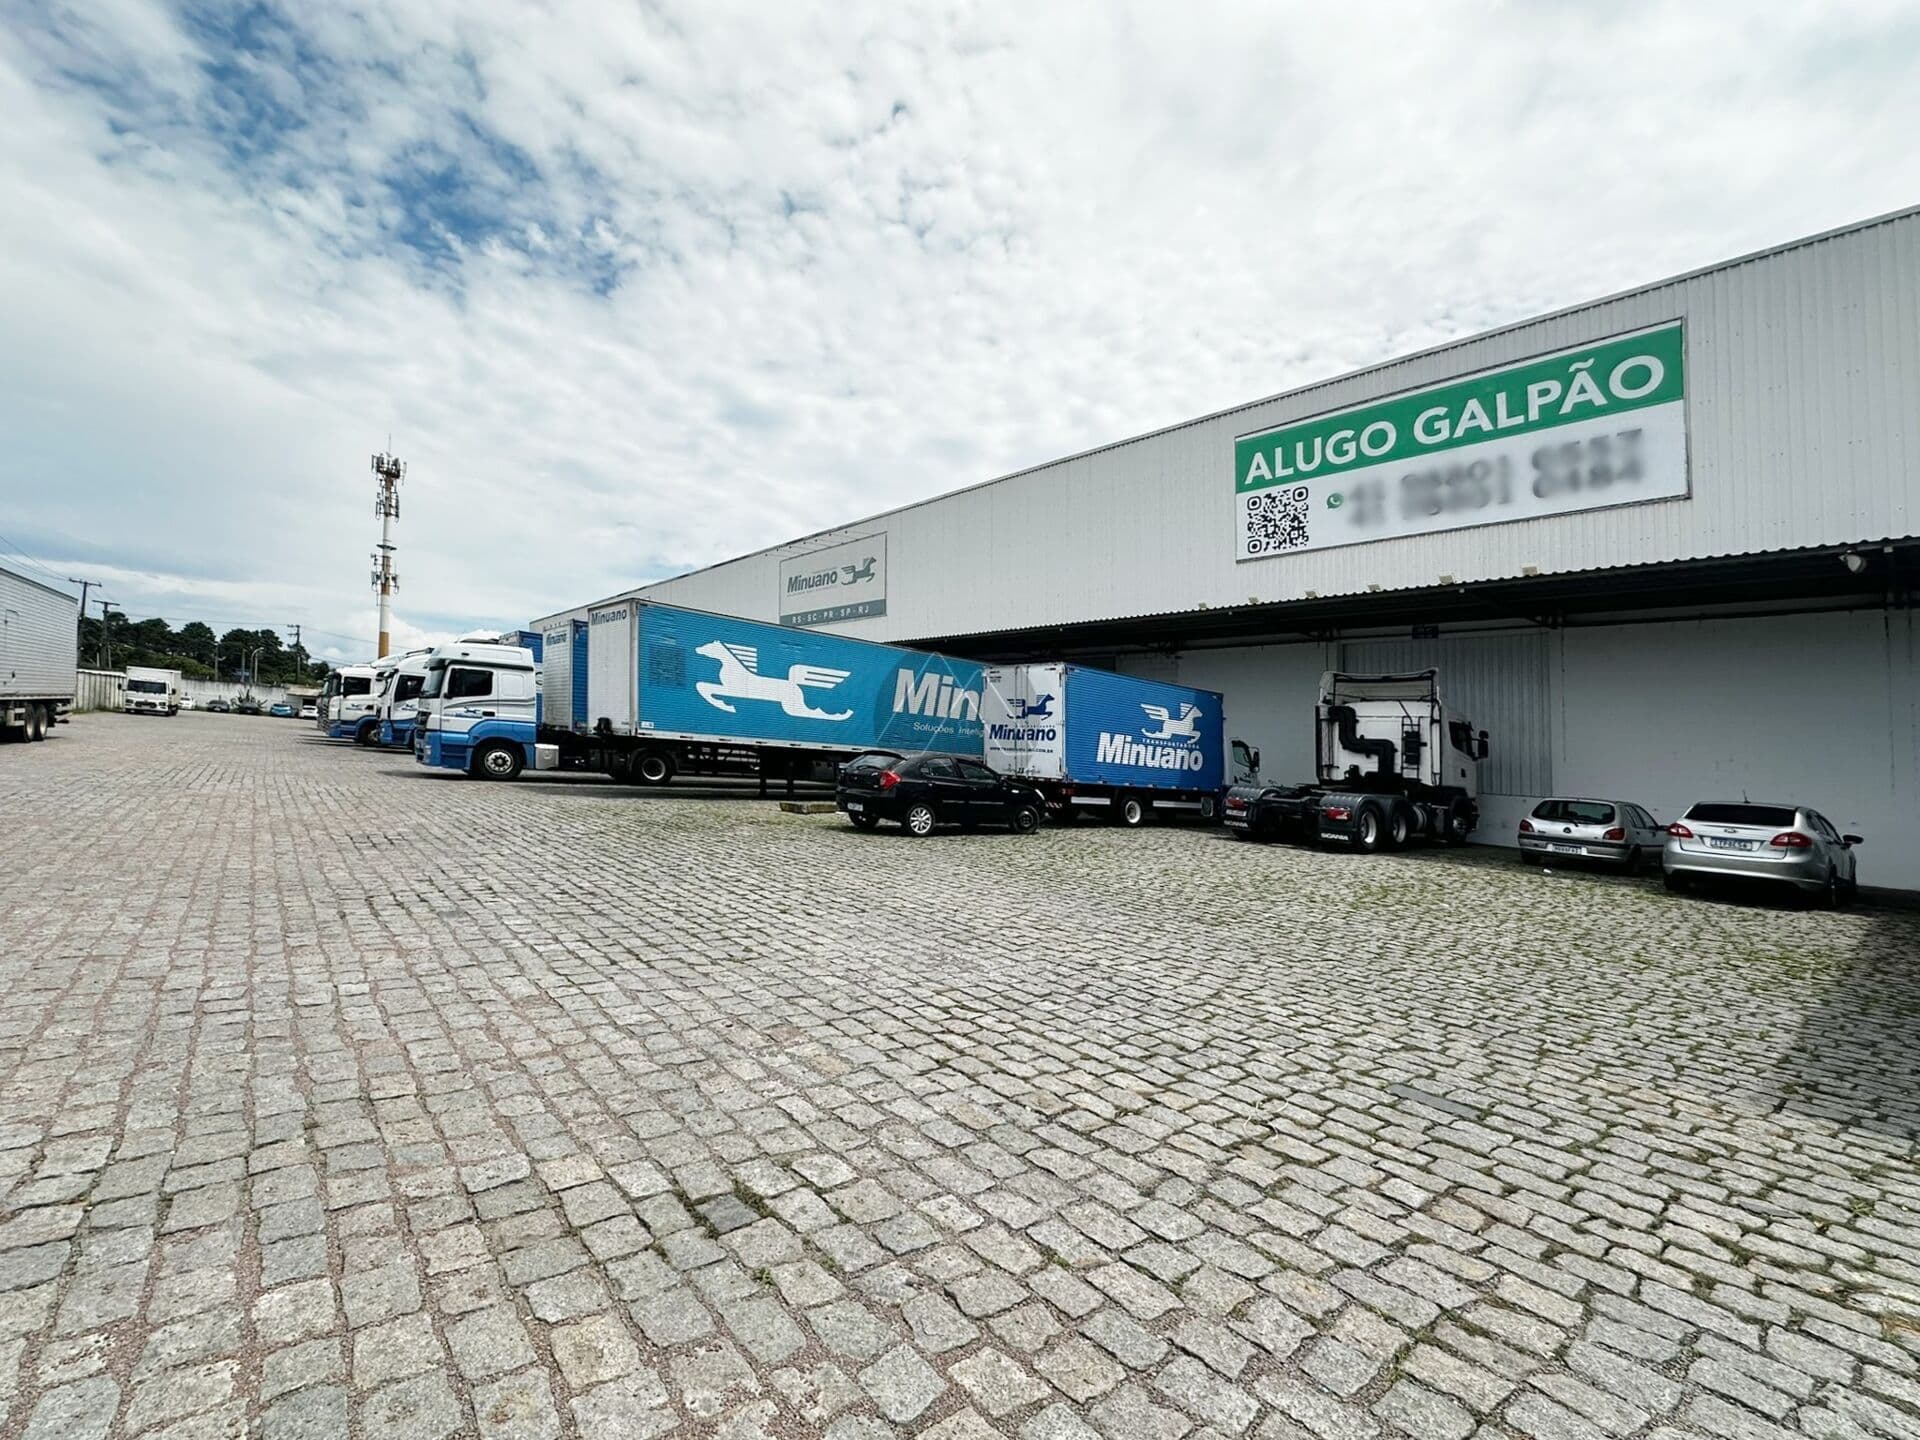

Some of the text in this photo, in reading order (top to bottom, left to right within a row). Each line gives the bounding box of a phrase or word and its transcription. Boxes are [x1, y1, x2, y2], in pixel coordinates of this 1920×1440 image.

[1244, 355, 1665, 485] ALUGO GALPÃO
[786, 570, 838, 593] Minuano
[591, 608, 628, 626] Minuano
[892, 668, 985, 724] Min
[989, 724, 1057, 741] Minuano
[1096, 732, 1204, 771] Minuano
[1321, 832, 1349, 841] SCANIA
